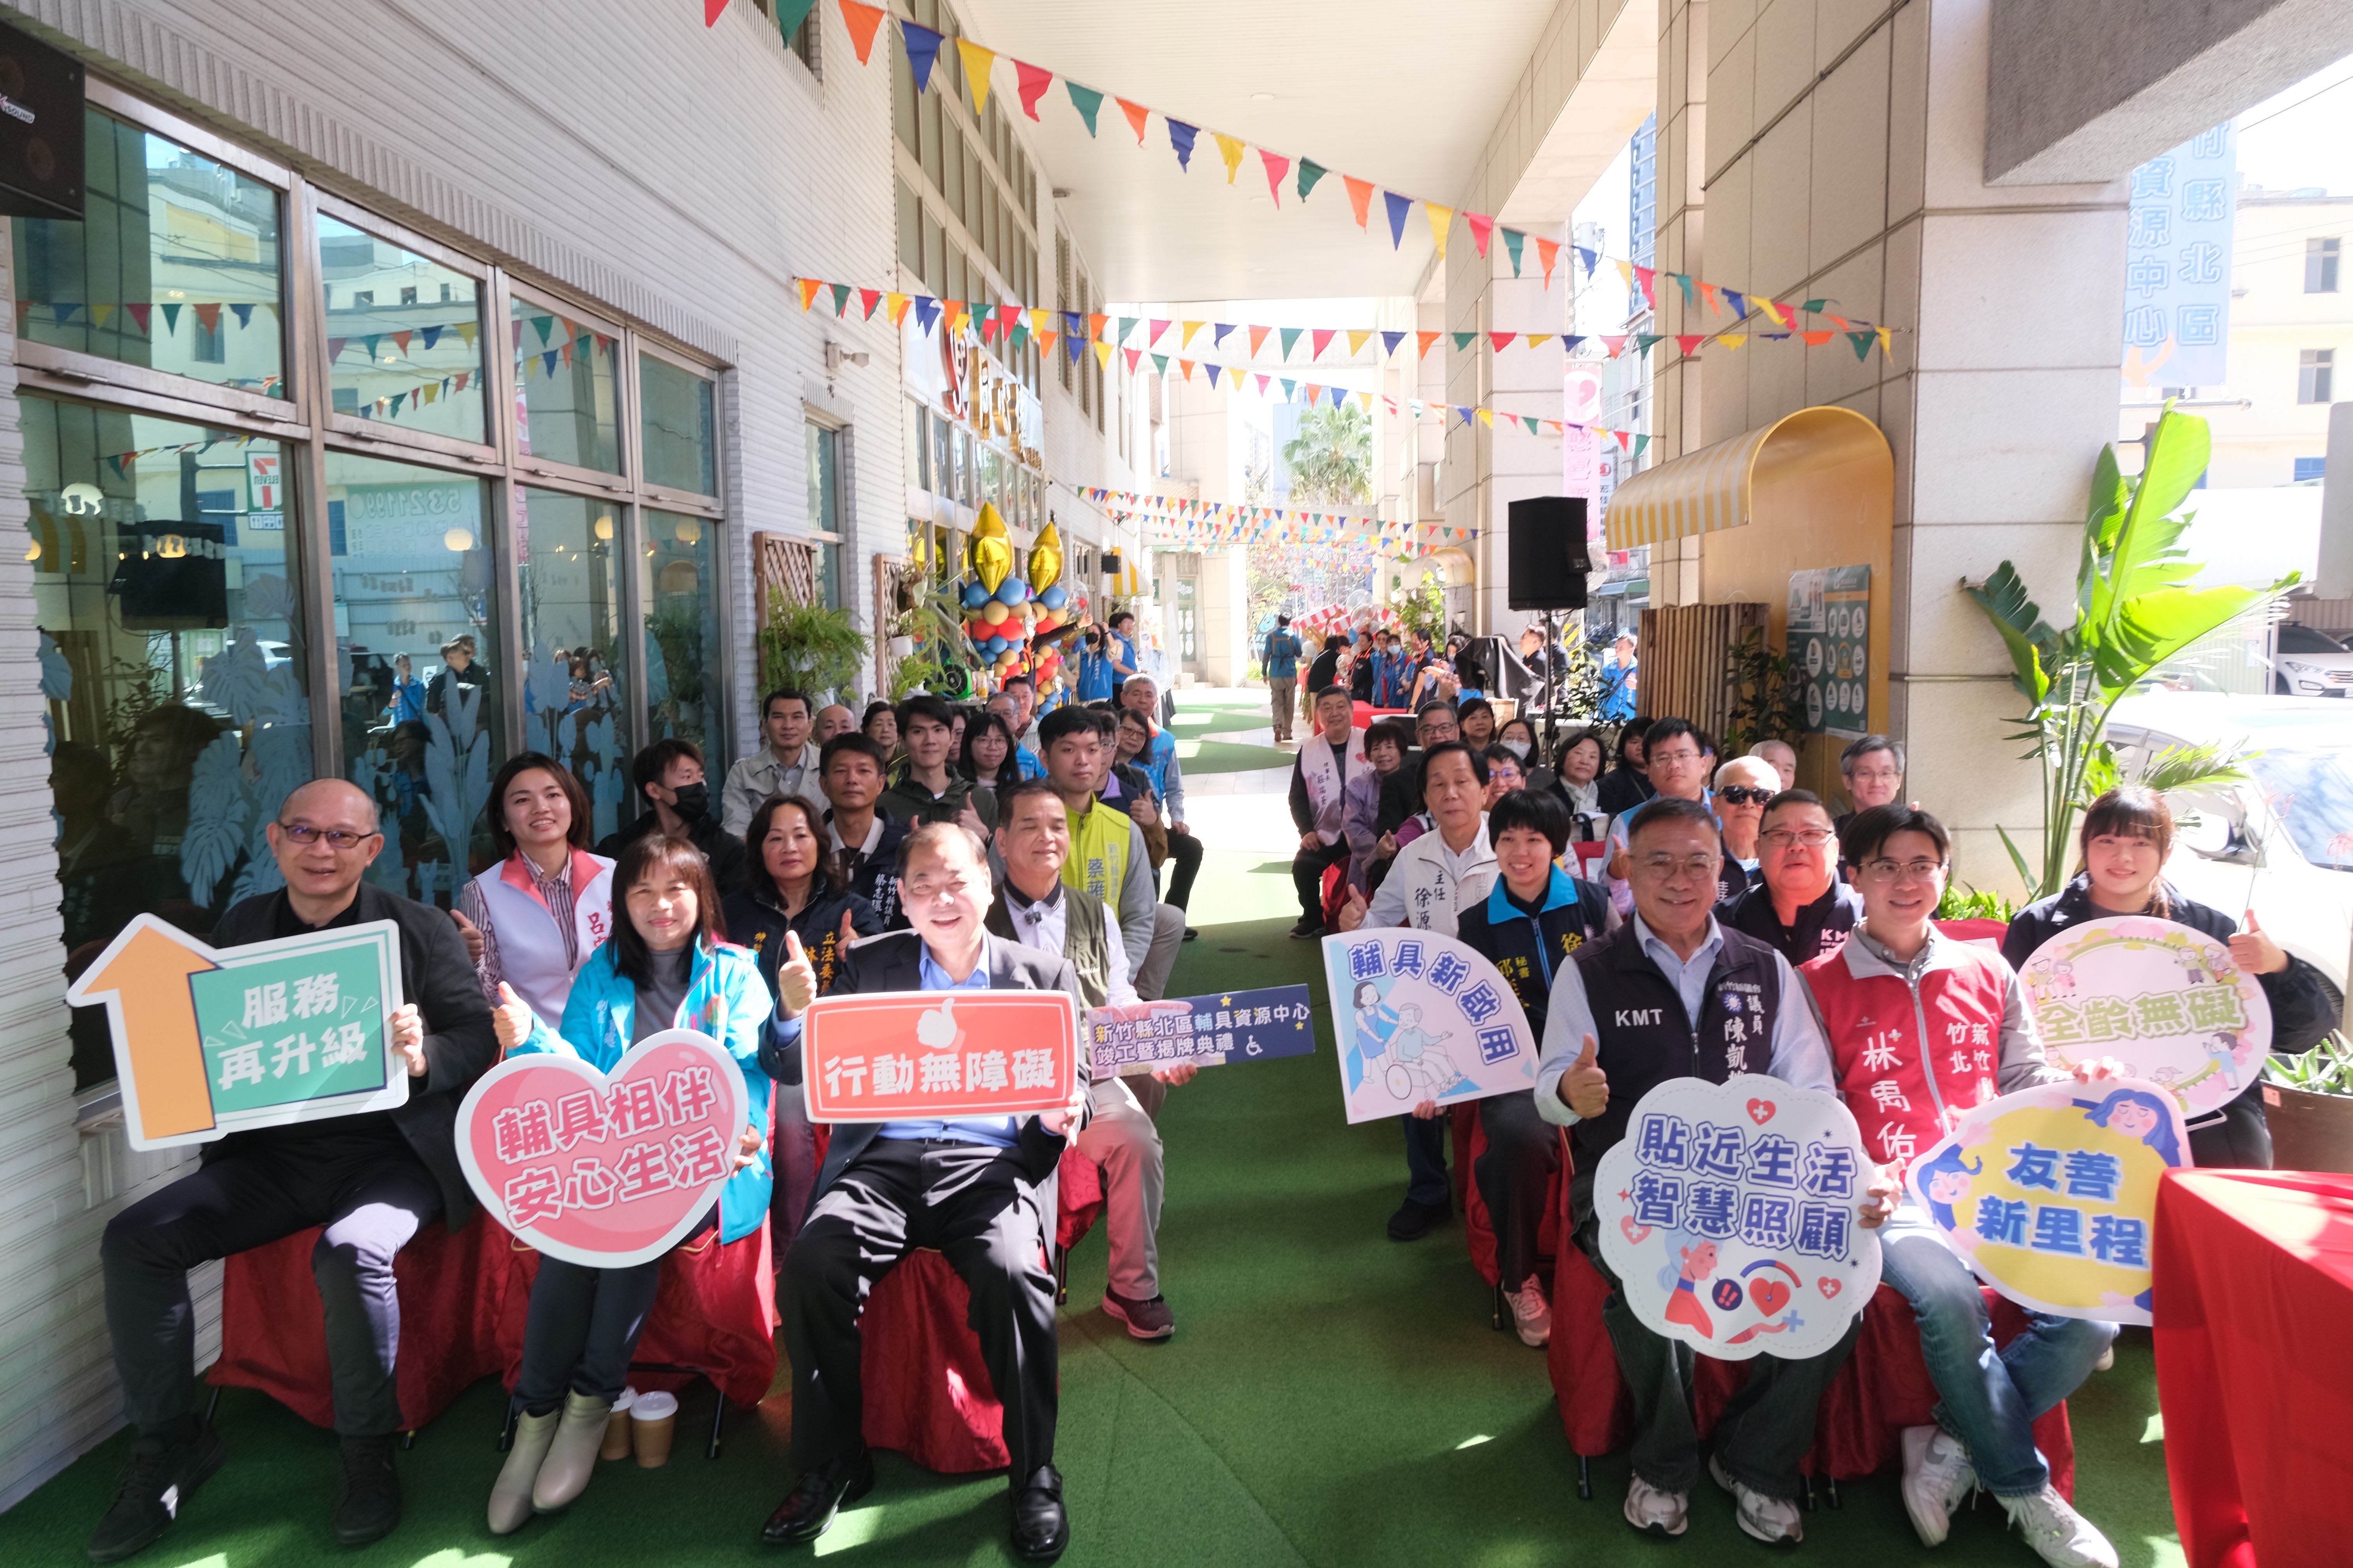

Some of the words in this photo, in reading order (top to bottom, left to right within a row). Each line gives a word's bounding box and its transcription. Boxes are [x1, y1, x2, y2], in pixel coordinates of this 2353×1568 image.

[2123, 156, 2175, 347] 資源中心
[1434, 870, 1446, 901] 主任
[241, 972, 340, 1029] 服務
[1094, 1002, 1311, 1044] 新竹縣北區輔具資源中心
[1615, 1008, 1663, 1027] KMT
[1747, 994, 1765, 1035] 議員
[2036, 985, 2247, 1046] 全齡無礙
[217, 1021, 369, 1090] 再升級
[824, 1048, 1056, 1098] 行動無障礙
[1095, 1032, 1235, 1066] 竣工暨揭牌典禮
[1946, 1022, 1972, 1074] 竹北
[495, 1067, 717, 1164] 輔具相伴
[1862, 1031, 1917, 1159] 林禹佑
[505, 1126, 728, 1228] 安心生活
[1636, 1114, 1857, 1198] 貼近生活
[2005, 1141, 2122, 1203] 友善
[1631, 1170, 1851, 1261] 智慧照顧
[1976, 1195, 2152, 1269] 新里程
